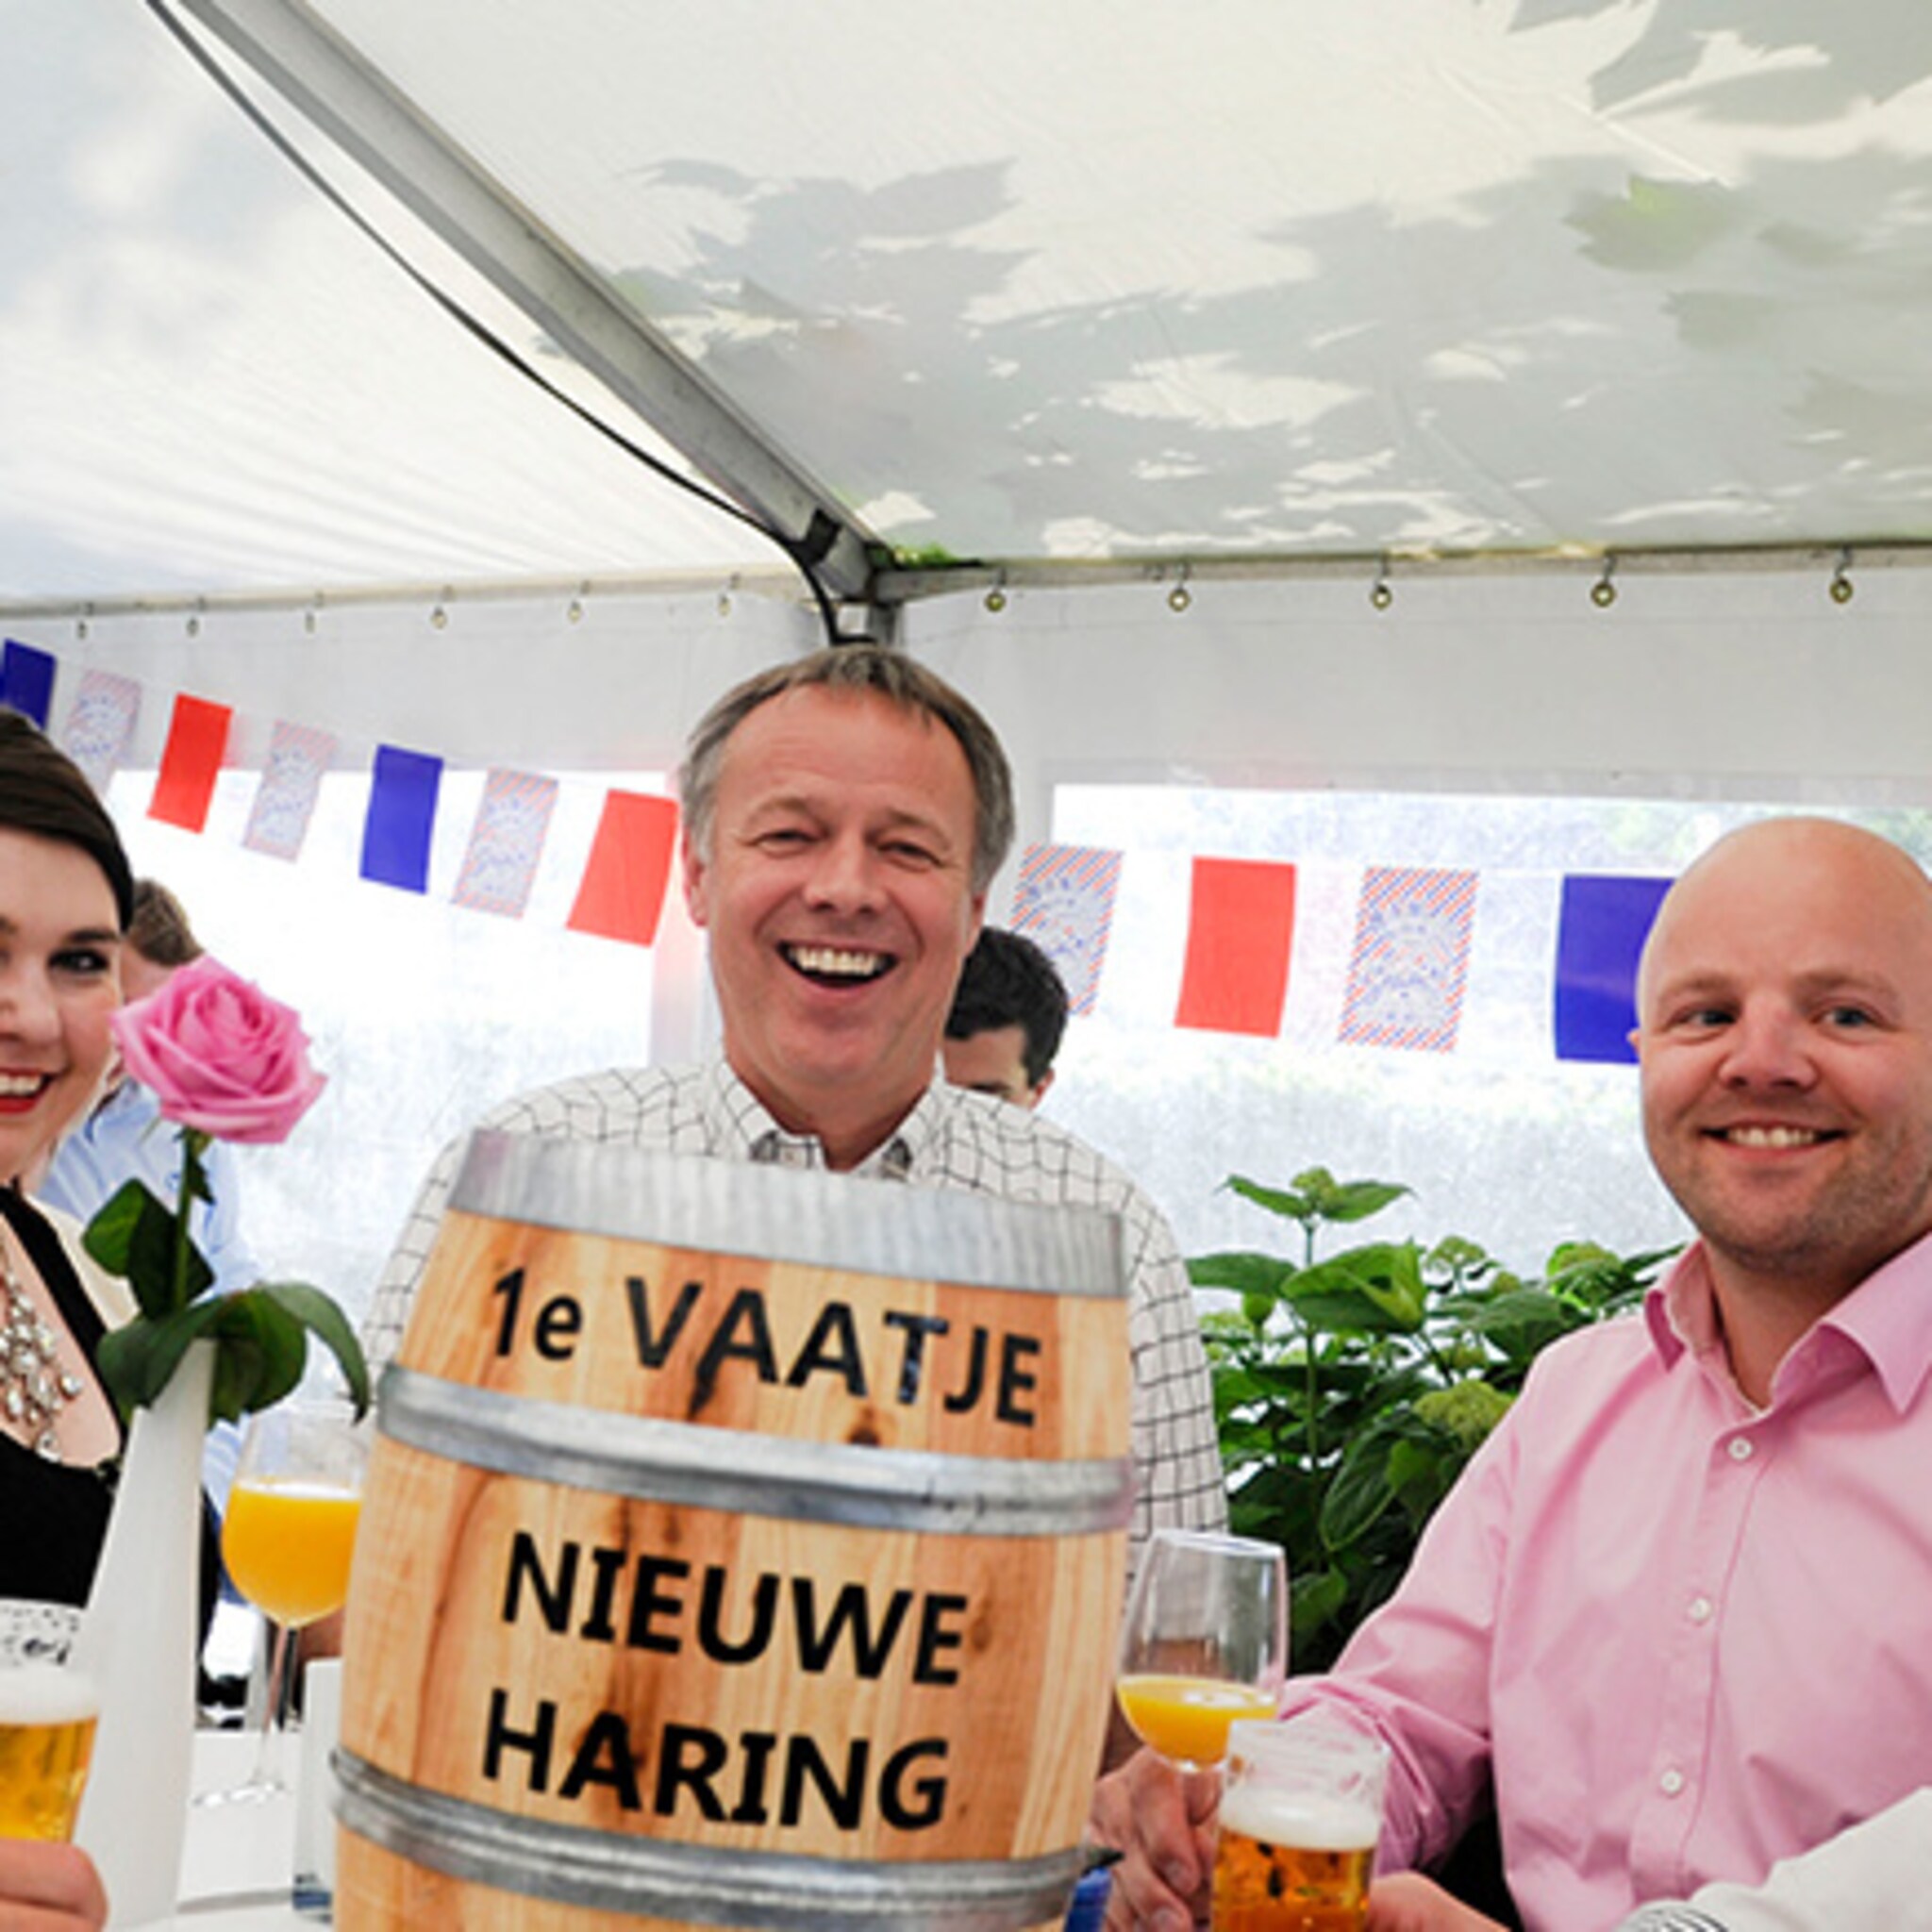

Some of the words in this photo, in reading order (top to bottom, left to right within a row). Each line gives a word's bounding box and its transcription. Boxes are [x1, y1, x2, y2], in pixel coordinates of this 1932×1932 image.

[491, 1268, 583, 1359] 1e
[625, 1276, 1041, 1427] VAATJE
[502, 1531, 968, 1686] NIEUWE
[482, 1689, 949, 1831] HARING
